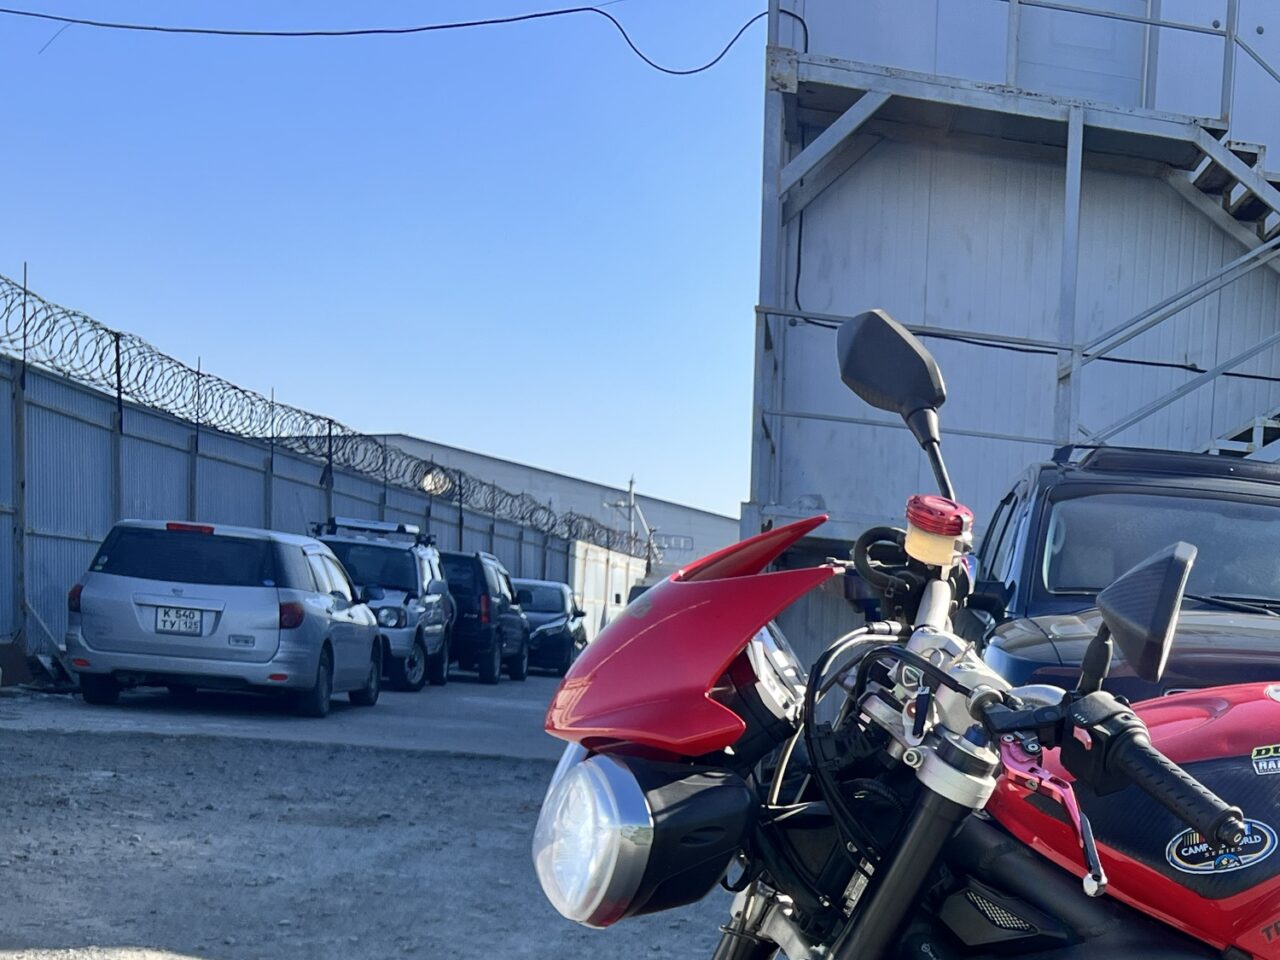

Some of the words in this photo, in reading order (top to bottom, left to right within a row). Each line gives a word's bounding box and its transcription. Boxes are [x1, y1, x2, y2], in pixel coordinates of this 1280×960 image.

[175, 610, 195, 620] 540
[161, 619, 177, 629] ТУ
[182, 621, 199, 630] 125
[1181, 842, 1213, 857] CAMP
